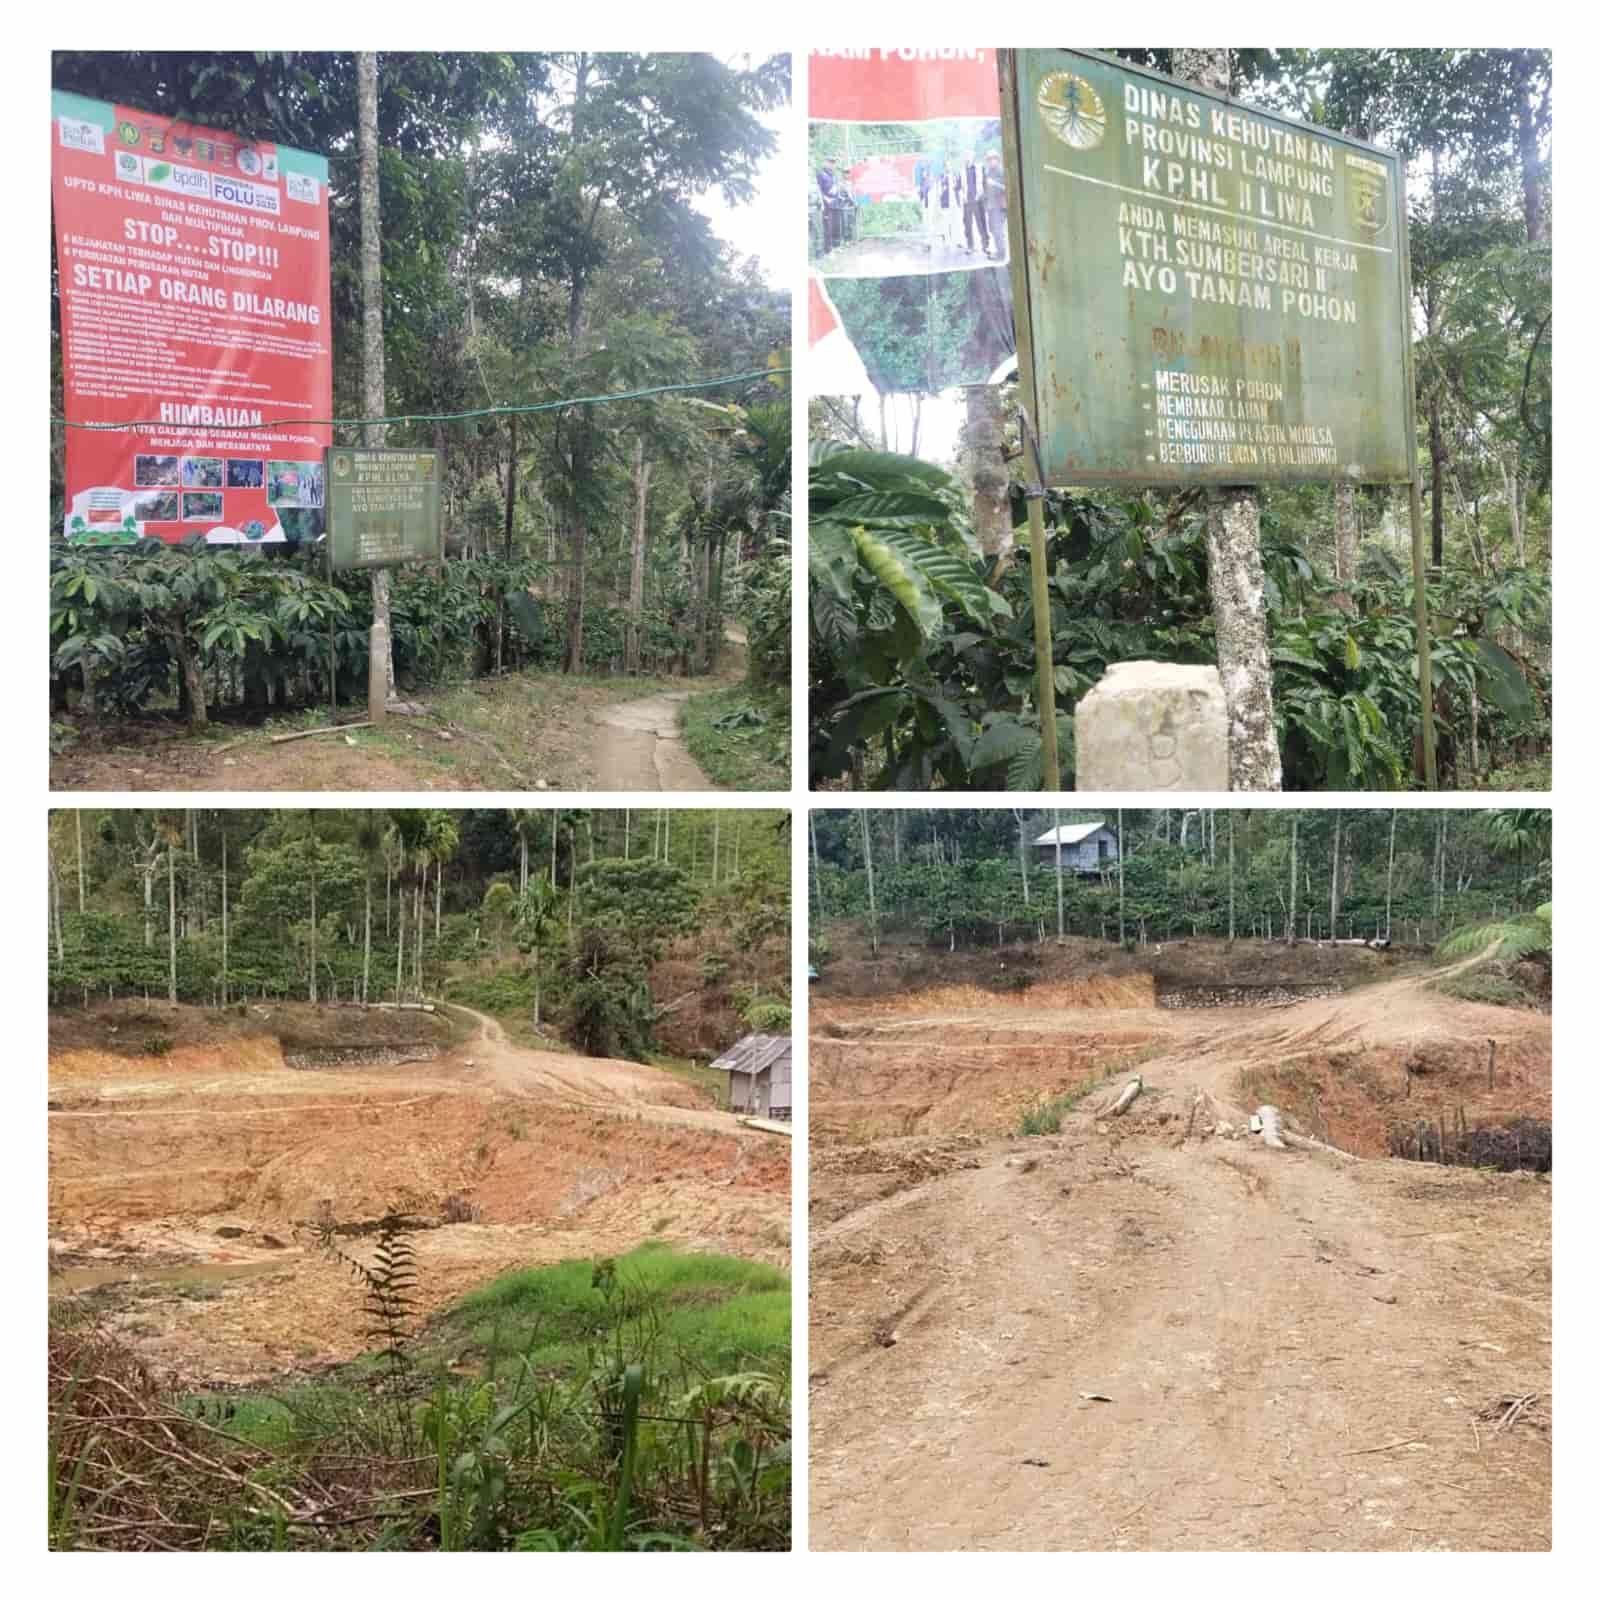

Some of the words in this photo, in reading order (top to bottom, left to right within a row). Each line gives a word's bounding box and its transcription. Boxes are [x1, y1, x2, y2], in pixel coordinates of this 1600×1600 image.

[1124, 83, 1201, 128] DINAS
[1211, 109, 1335, 170] KEHUTANAN
[1125, 118, 1233, 171] PROVINSI
[1241, 150, 1333, 197] LAMPUNG
[214, 184, 254, 206] FOLU
[1260, 186, 1315, 229] LIWA
[1119, 202, 1166, 233] ANDA
[1173, 213, 1257, 250] MEMASUKI
[1264, 233, 1310, 262] AREAL
[1314, 247, 1358, 273] KERJA
[73, 263, 152, 295] SETIAP
[159, 278, 226, 310] ORANG
[232, 291, 320, 325] DILARANG
[1122, 260, 1177, 294] AYO
[1184, 270, 1272, 311] TANAM
[1282, 288, 1357, 323] POHON
[1155, 370, 1231, 398] MERUSAK
[1156, 394, 1225, 418] MEMBAKAR
[159, 402, 263, 427] HIMBAUAN
